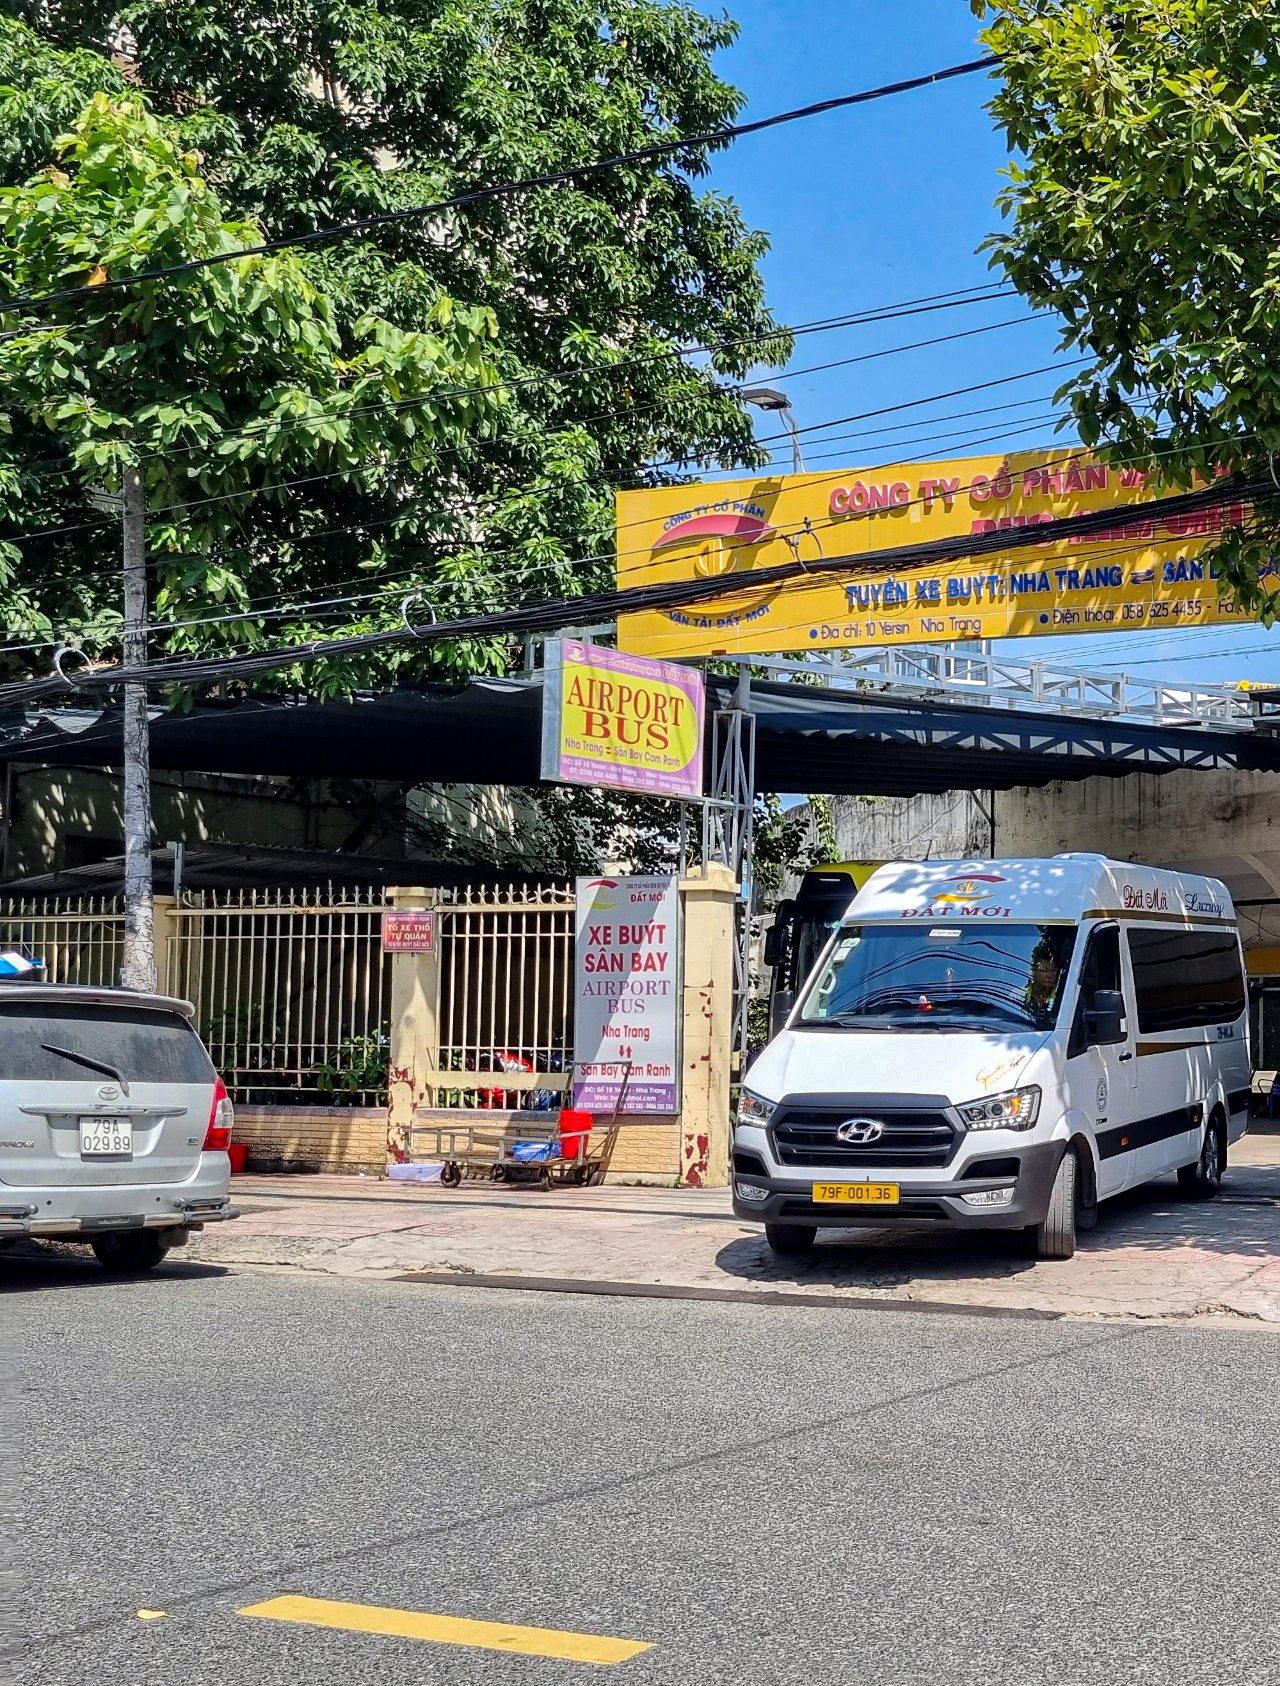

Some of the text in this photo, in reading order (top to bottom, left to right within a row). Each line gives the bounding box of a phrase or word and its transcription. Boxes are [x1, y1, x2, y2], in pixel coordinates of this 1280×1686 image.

[830, 481, 909, 514] CÔNG
[919, 478, 960, 505] TY
[970, 459, 1013, 500] CỔ
[1023, 457, 1108, 497] PHẦN
[916, 578, 941, 600] XE
[1010, 571, 1051, 594] NHA
[1055, 565, 1124, 591] TRANG
[1122, 605, 1144, 619] 058
[1150, 602, 1169, 618] 625
[1172, 600, 1202, 616] 4455
[865, 622, 876, 637] 10
[879, 620, 909, 636] Yersin
[921, 618, 944, 633] Nha
[949, 616, 981, 633] Trang
[566, 674, 685, 727] AIRPORT
[581, 710, 669, 750] BUS
[565, 737, 581, 750] Nha
[583, 740, 604, 756] Trang
[629, 749, 643, 762] Bay
[645, 752, 661, 764] Cam
[663, 755, 681, 767] Ranh
[630, 890, 647, 902] ĐẤT
[1185, 893, 1225, 917] Luxury
[900, 903, 1013, 918] ĐẤT MỚI
[588, 919, 666, 945] XE BUÝT
[584, 947, 669, 973] SÂN BAY
[583, 980, 670, 996] AIRPORT
[607, 999, 645, 1014] BUS
[602, 1025, 650, 1041] Nha Trang
[601, 1063, 618, 1078] Bay
[647, 1064, 671, 1076] Ranh
[93, 1119, 120, 1134] 79A
[83, 1136, 131, 1151] 029.89
[820, 1186, 891, 1201] 79F-001.36
